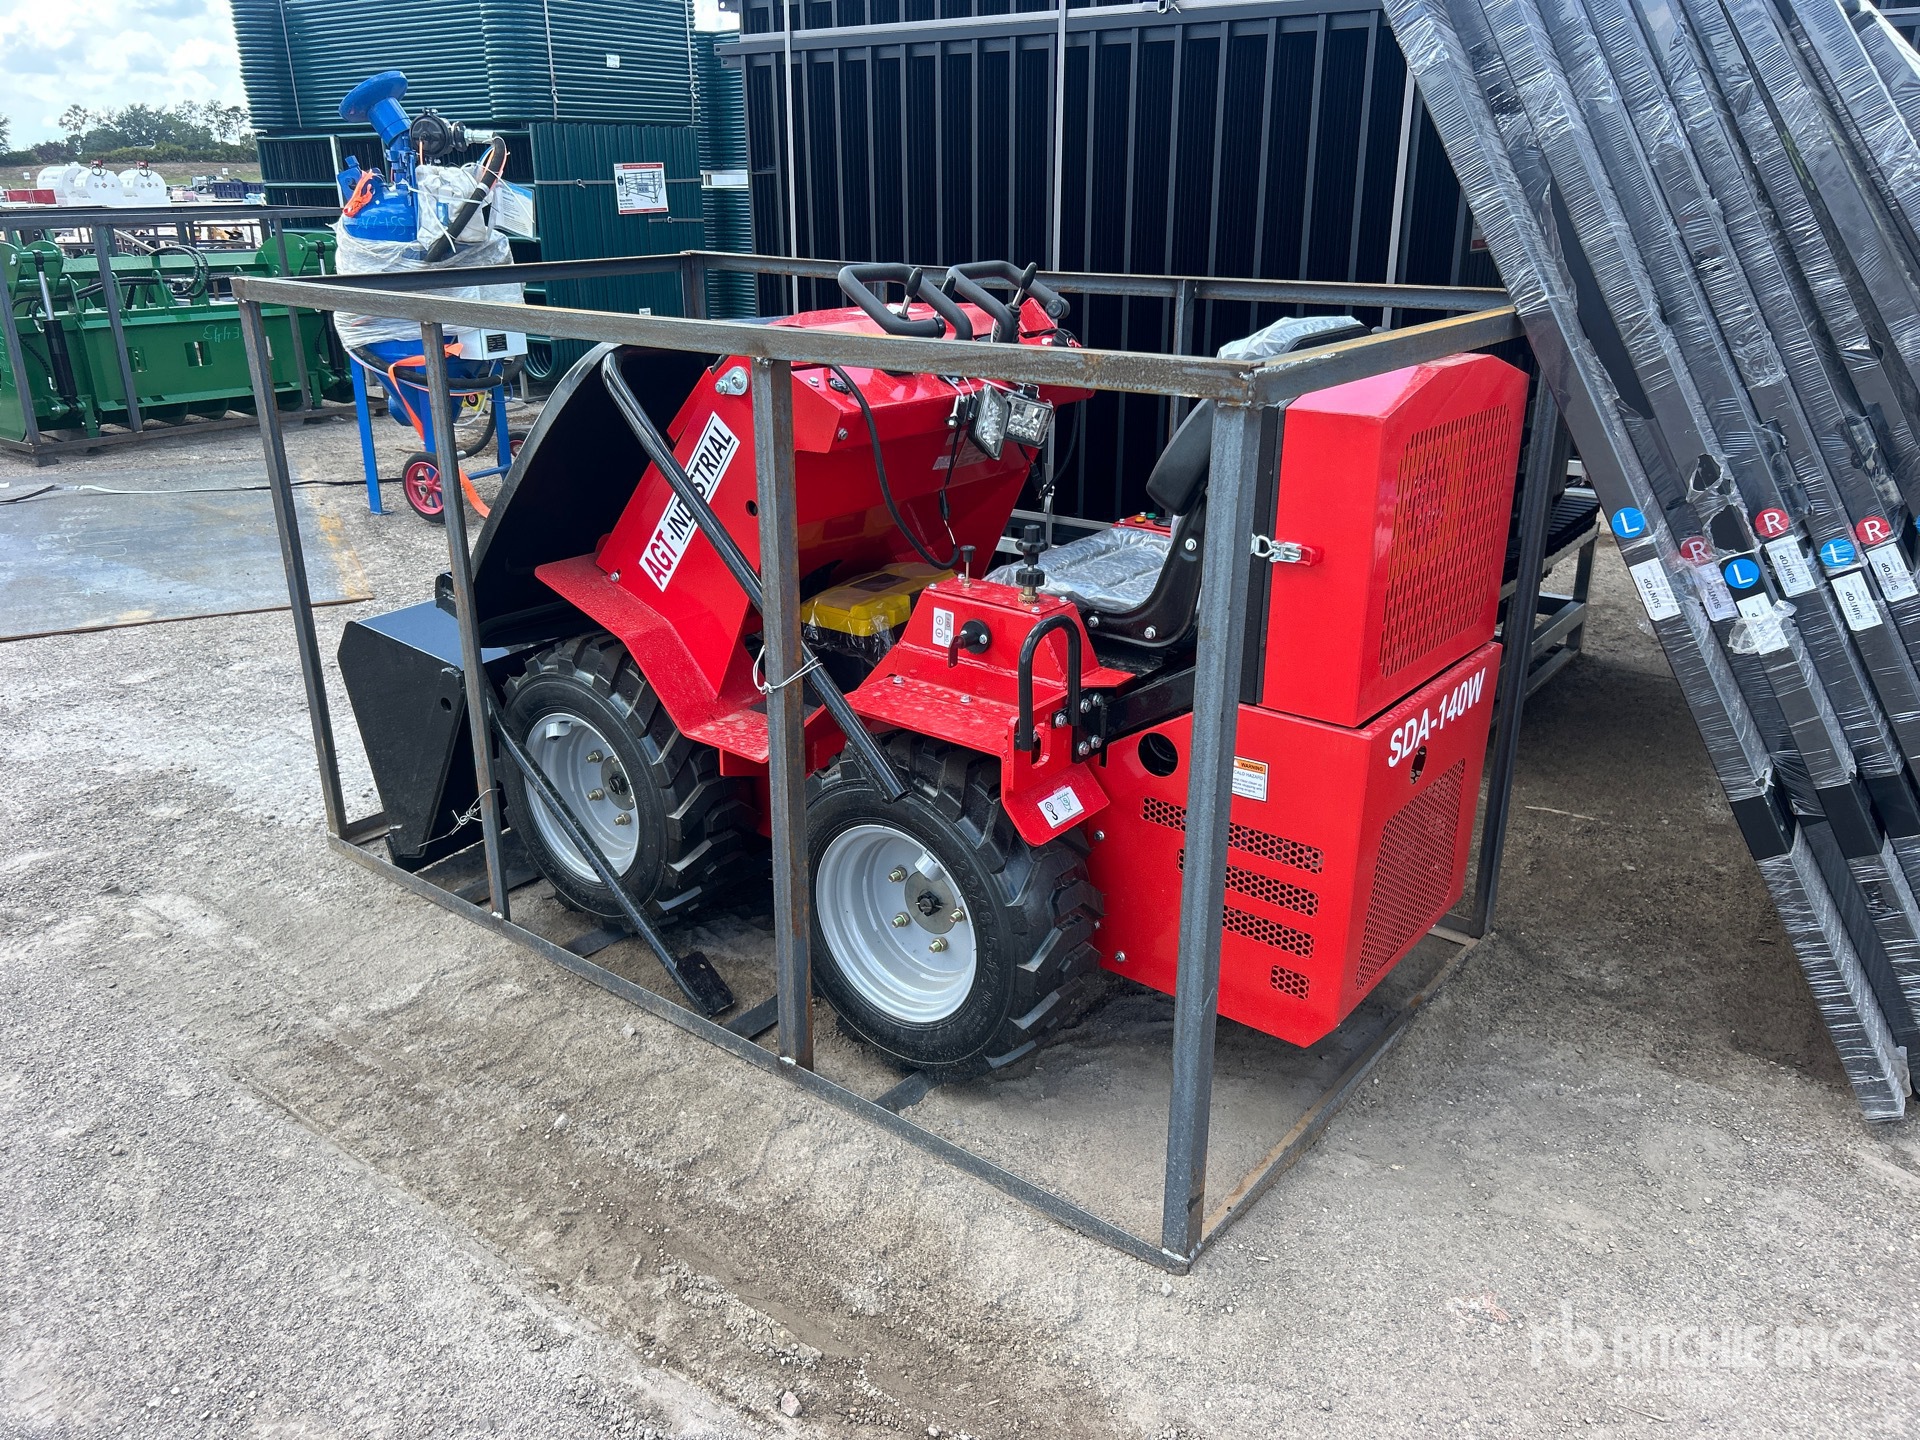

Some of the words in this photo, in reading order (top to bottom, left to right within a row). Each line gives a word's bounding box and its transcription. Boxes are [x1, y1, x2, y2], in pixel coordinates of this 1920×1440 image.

[644, 528, 678, 586] AGT
[667, 426, 732, 540] INDSTRIAL
[1620, 513, 1640, 533] L
[1763, 513, 1784, 533] R
[1864, 520, 1885, 541] R
[1690, 541, 1709, 562] R
[1829, 544, 1849, 563] L
[1732, 564, 1753, 584] L
[1780, 554, 1796, 583] SUNTOP
[1882, 562, 1898, 590] SUNTOP
[1644, 578, 1661, 608] SUNTOP
[1846, 591, 1862, 619] SUNTOP
[1388, 667, 1486, 768] SDA-140W
[1240, 762, 1264, 772] WARNING
